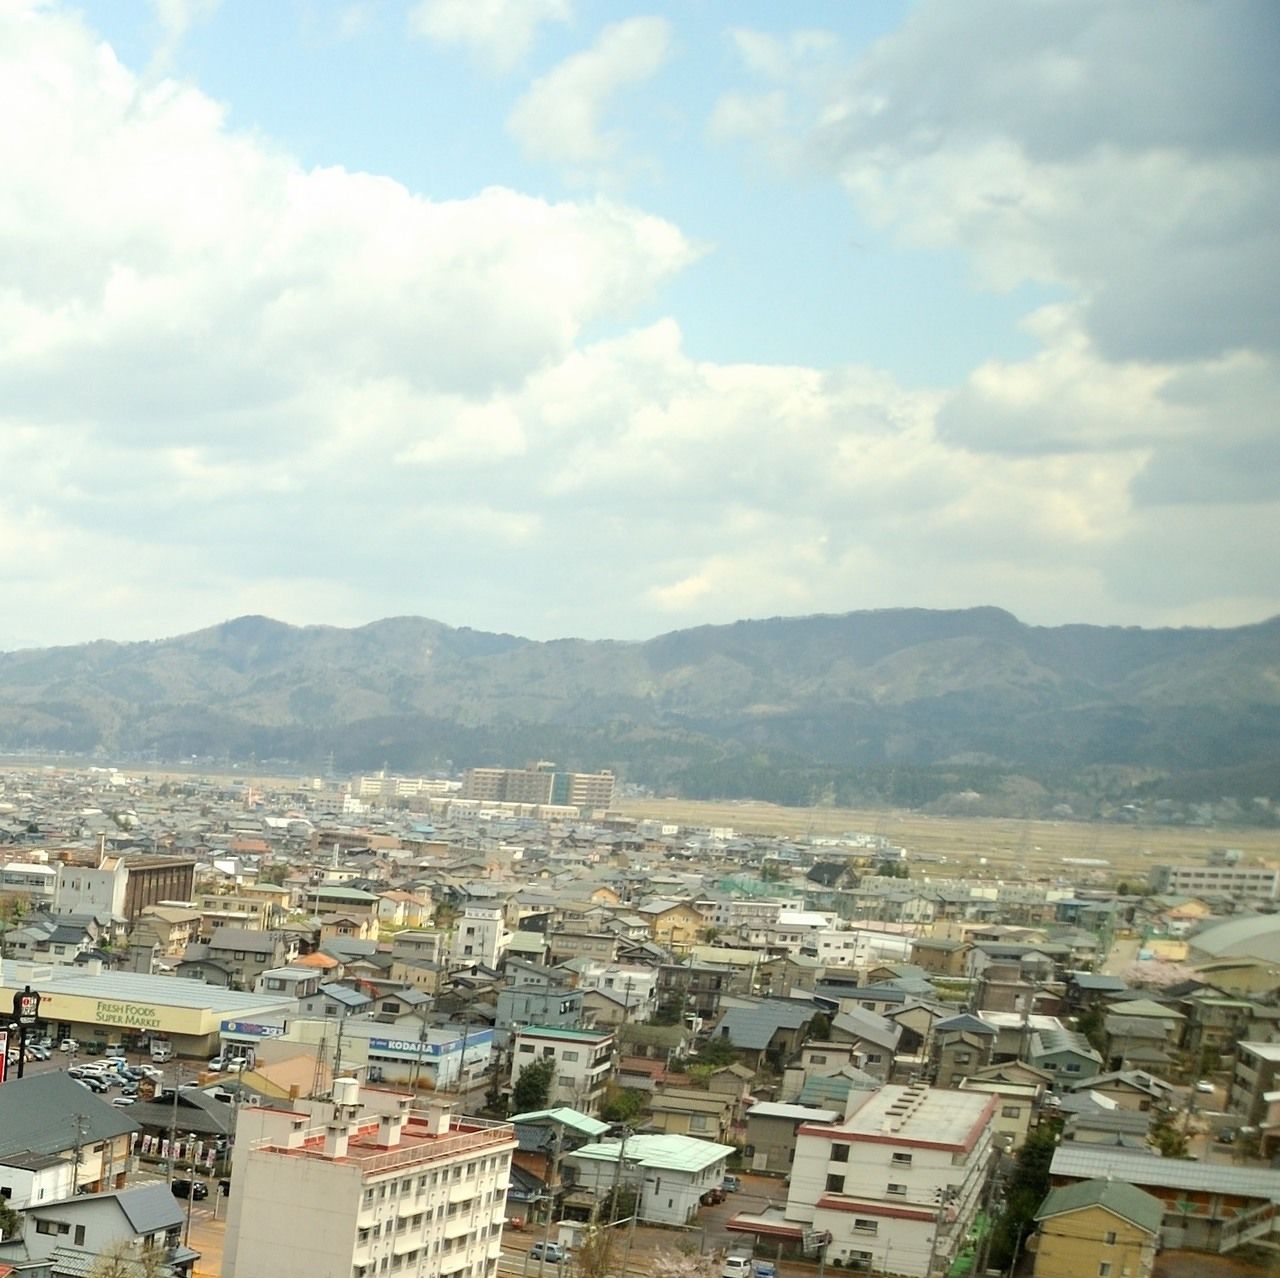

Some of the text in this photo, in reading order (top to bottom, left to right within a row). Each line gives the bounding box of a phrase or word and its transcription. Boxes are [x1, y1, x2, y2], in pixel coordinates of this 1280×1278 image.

[97, 1002, 155, 1017] FRESH FOODS
[96, 1012, 160, 1027] SUPER MARKET
